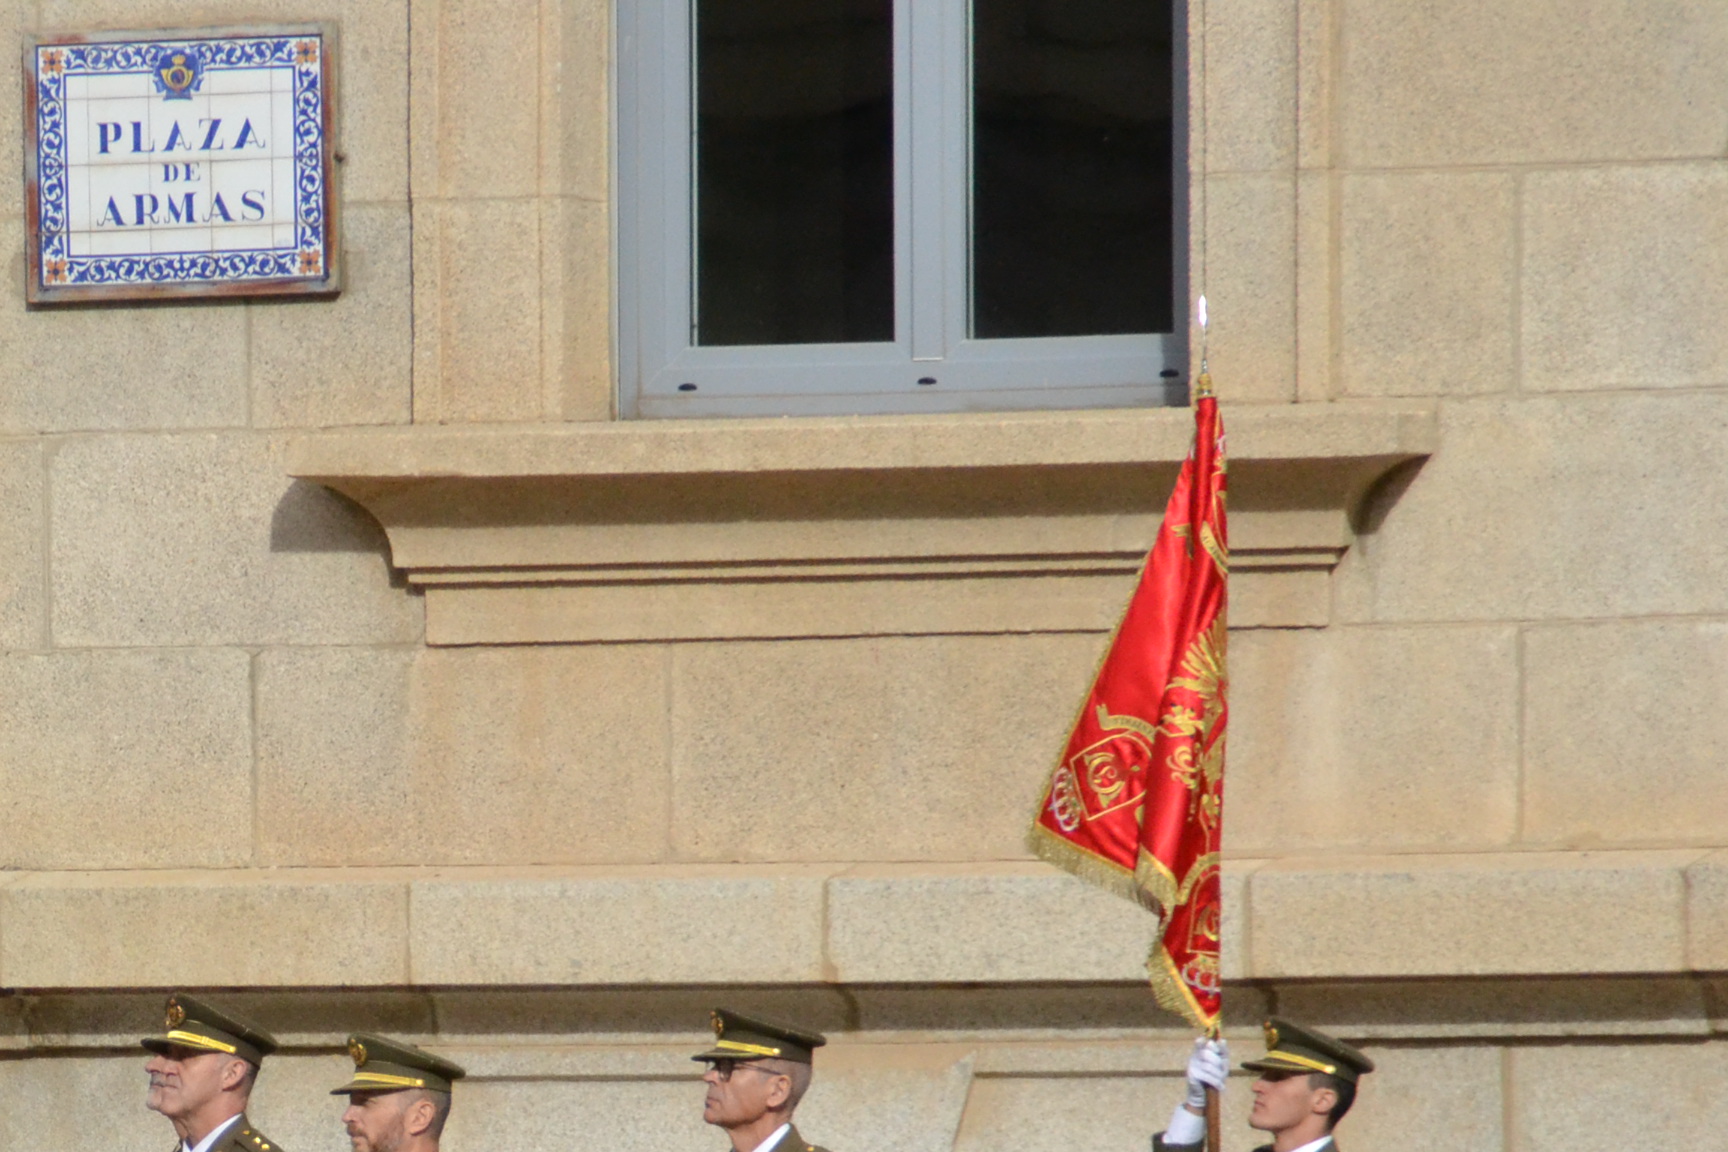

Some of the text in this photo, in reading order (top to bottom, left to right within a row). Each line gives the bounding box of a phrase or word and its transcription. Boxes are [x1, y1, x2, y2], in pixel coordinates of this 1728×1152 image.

[96, 117, 266, 154] PLAZA
[162, 162, 201, 183] DE
[96, 189, 266, 227] ARMAS
